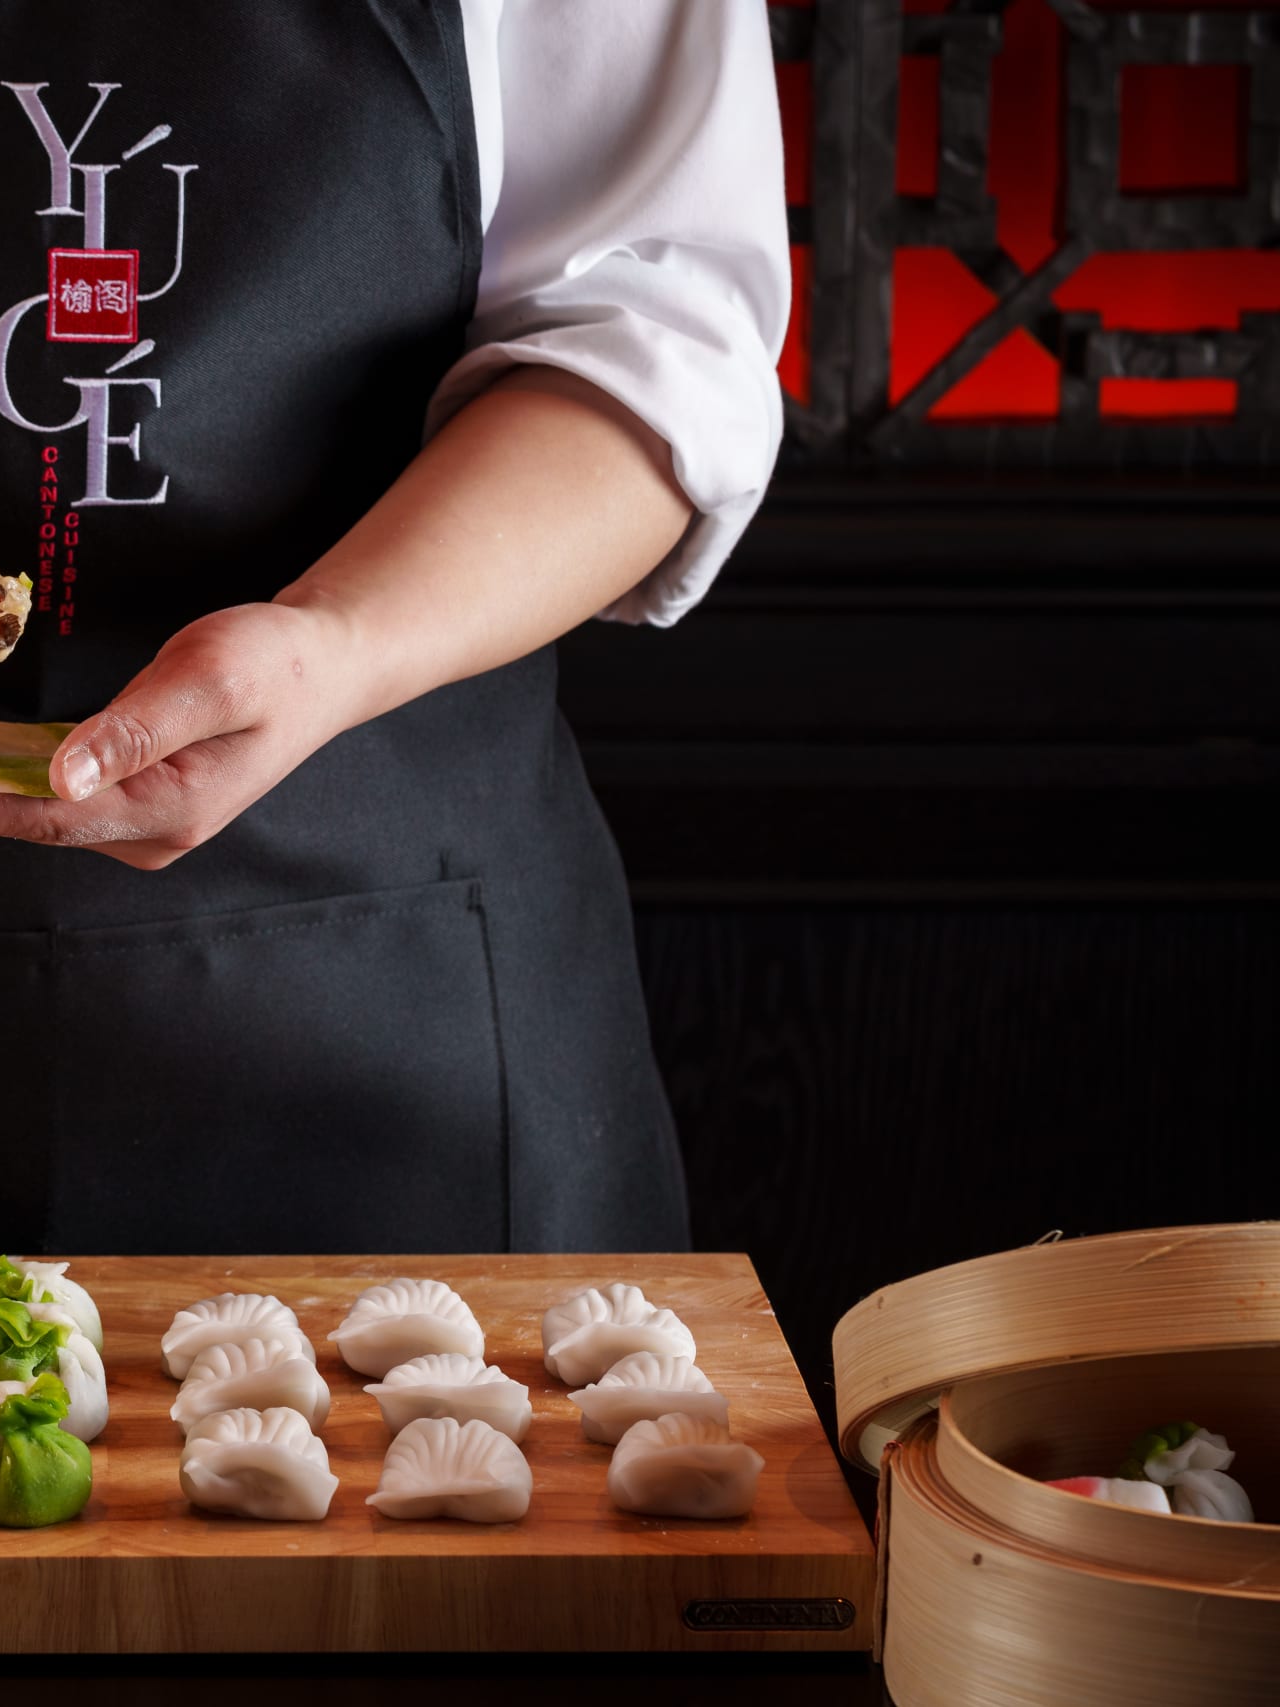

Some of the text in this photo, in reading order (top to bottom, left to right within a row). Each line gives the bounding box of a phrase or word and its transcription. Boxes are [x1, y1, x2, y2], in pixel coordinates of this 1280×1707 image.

[60, 278, 128, 314] 榆阁
[37, 445, 59, 612] CANTONESE
[59, 511, 80, 636] CUISINE
